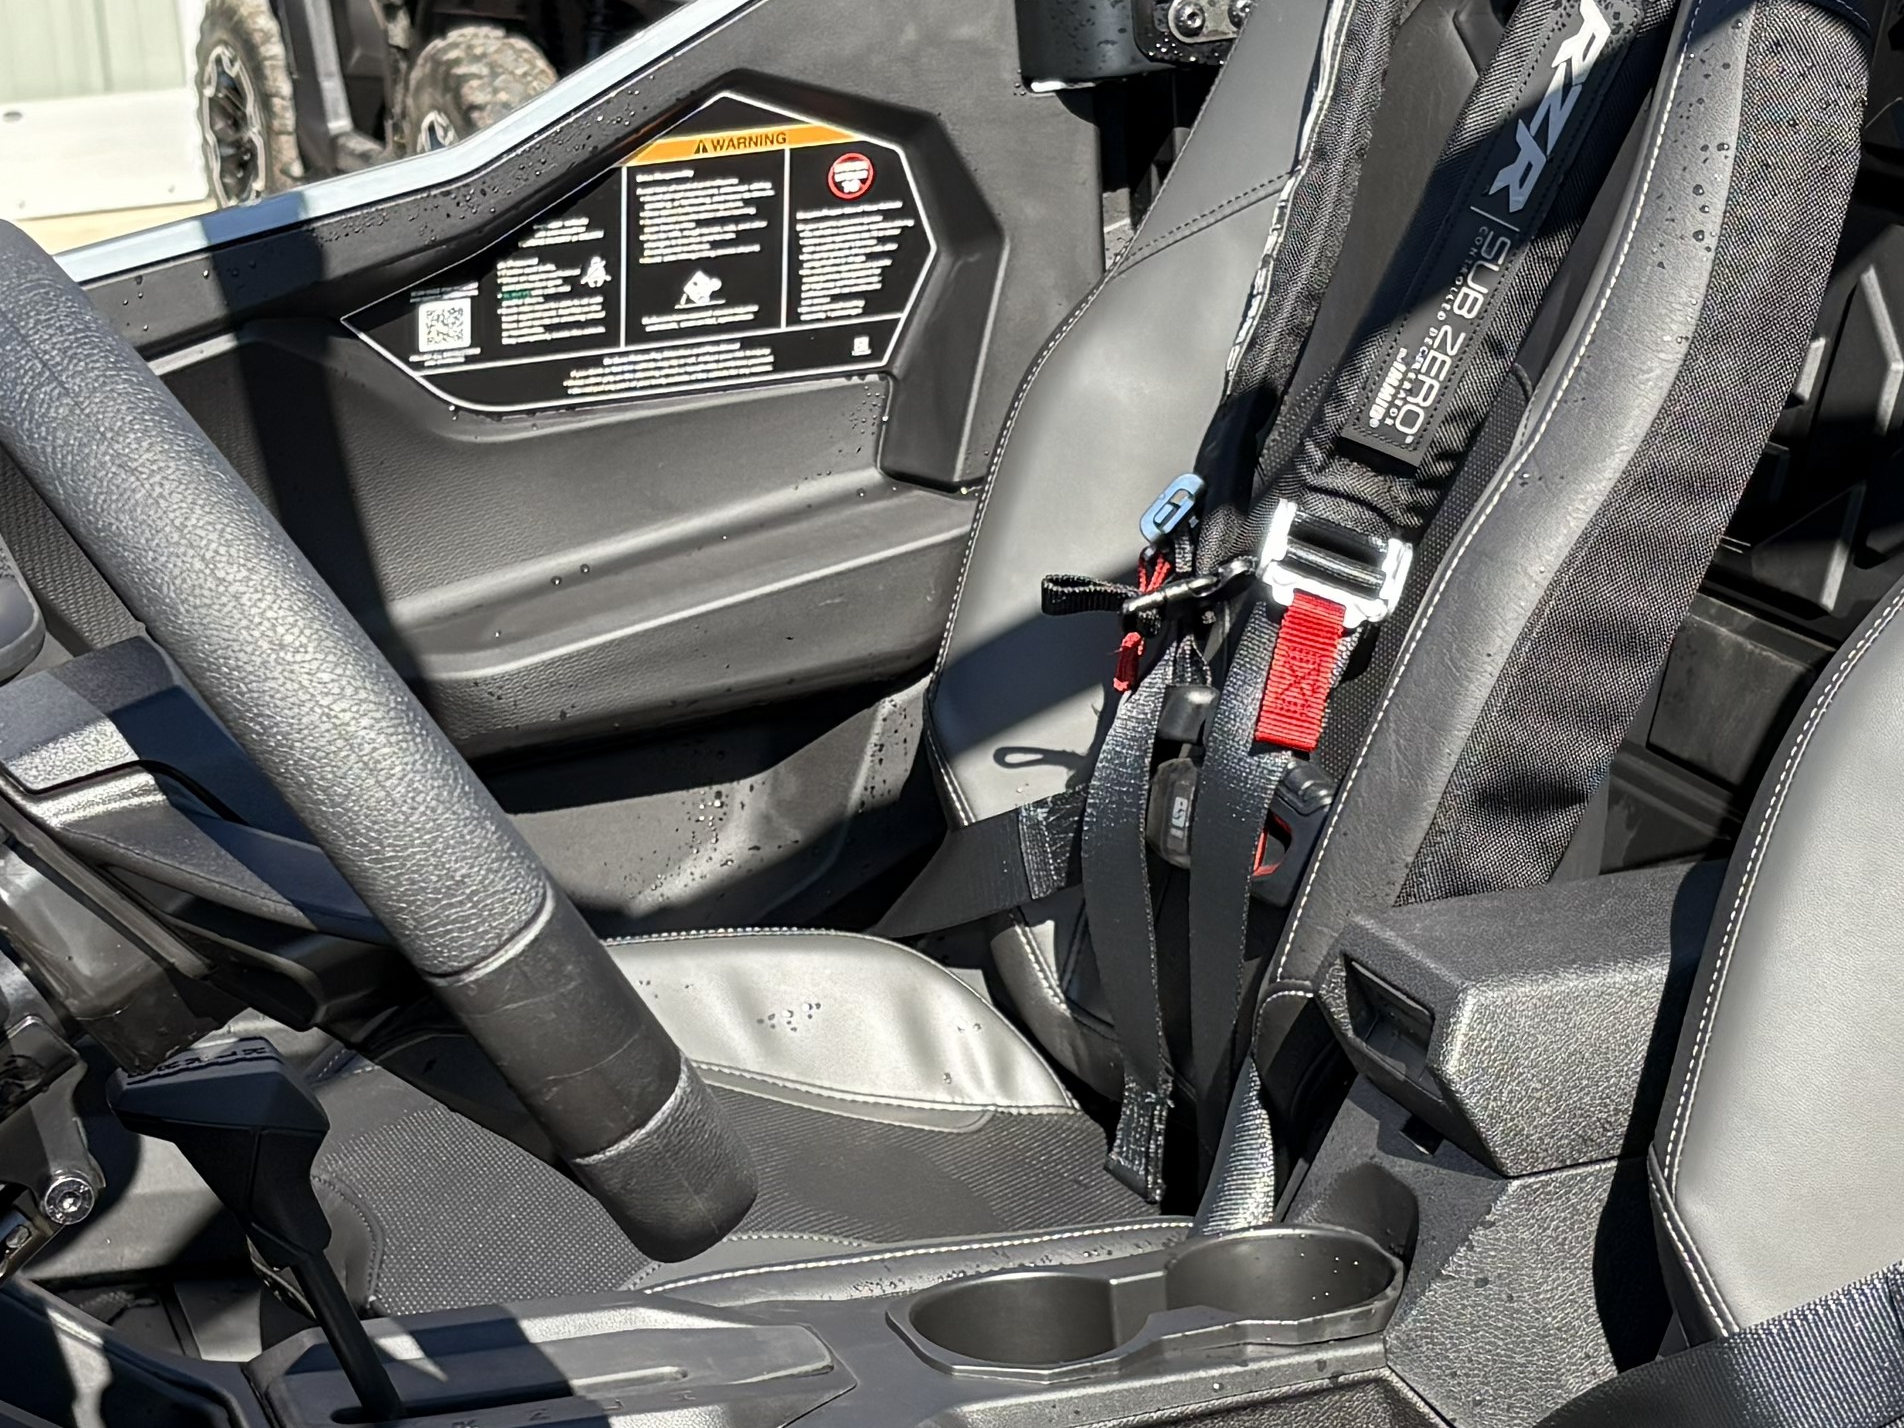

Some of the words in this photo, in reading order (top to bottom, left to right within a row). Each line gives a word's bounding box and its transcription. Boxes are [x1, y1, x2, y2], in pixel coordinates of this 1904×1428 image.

[710, 131, 788, 153] WARNING
[1436, 225, 1488, 321] CONTROLLED
[1452, 230, 1511, 320] SUB
[1394, 324, 1466, 435] ZERO
